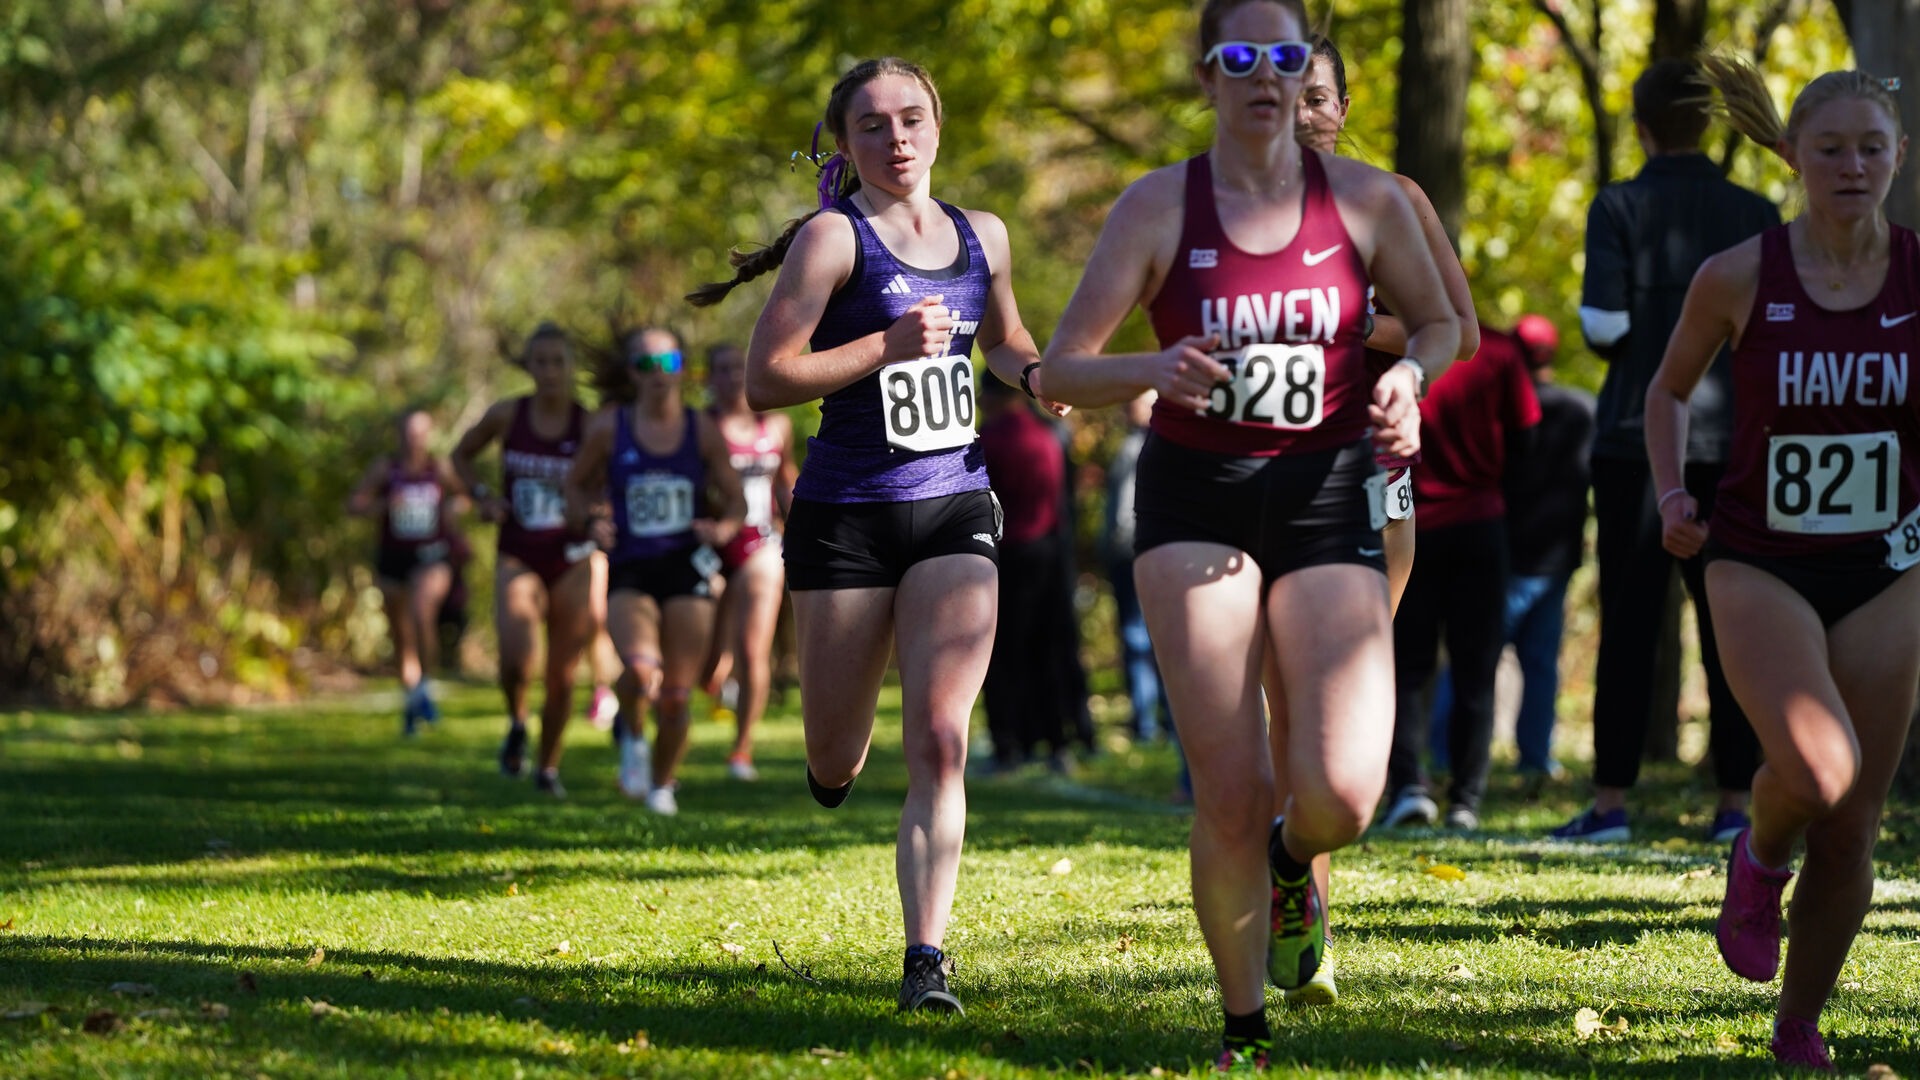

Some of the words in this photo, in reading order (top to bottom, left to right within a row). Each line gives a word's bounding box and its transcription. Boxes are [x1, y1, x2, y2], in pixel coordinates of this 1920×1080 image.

[1202, 286, 1340, 349] HAVEN
[887, 361, 973, 436] 806
[1779, 351, 1908, 406] HAVEN
[631, 484, 688, 523] 801
[1774, 441, 1889, 517] 821
[1902, 516, 1920, 554] 8
